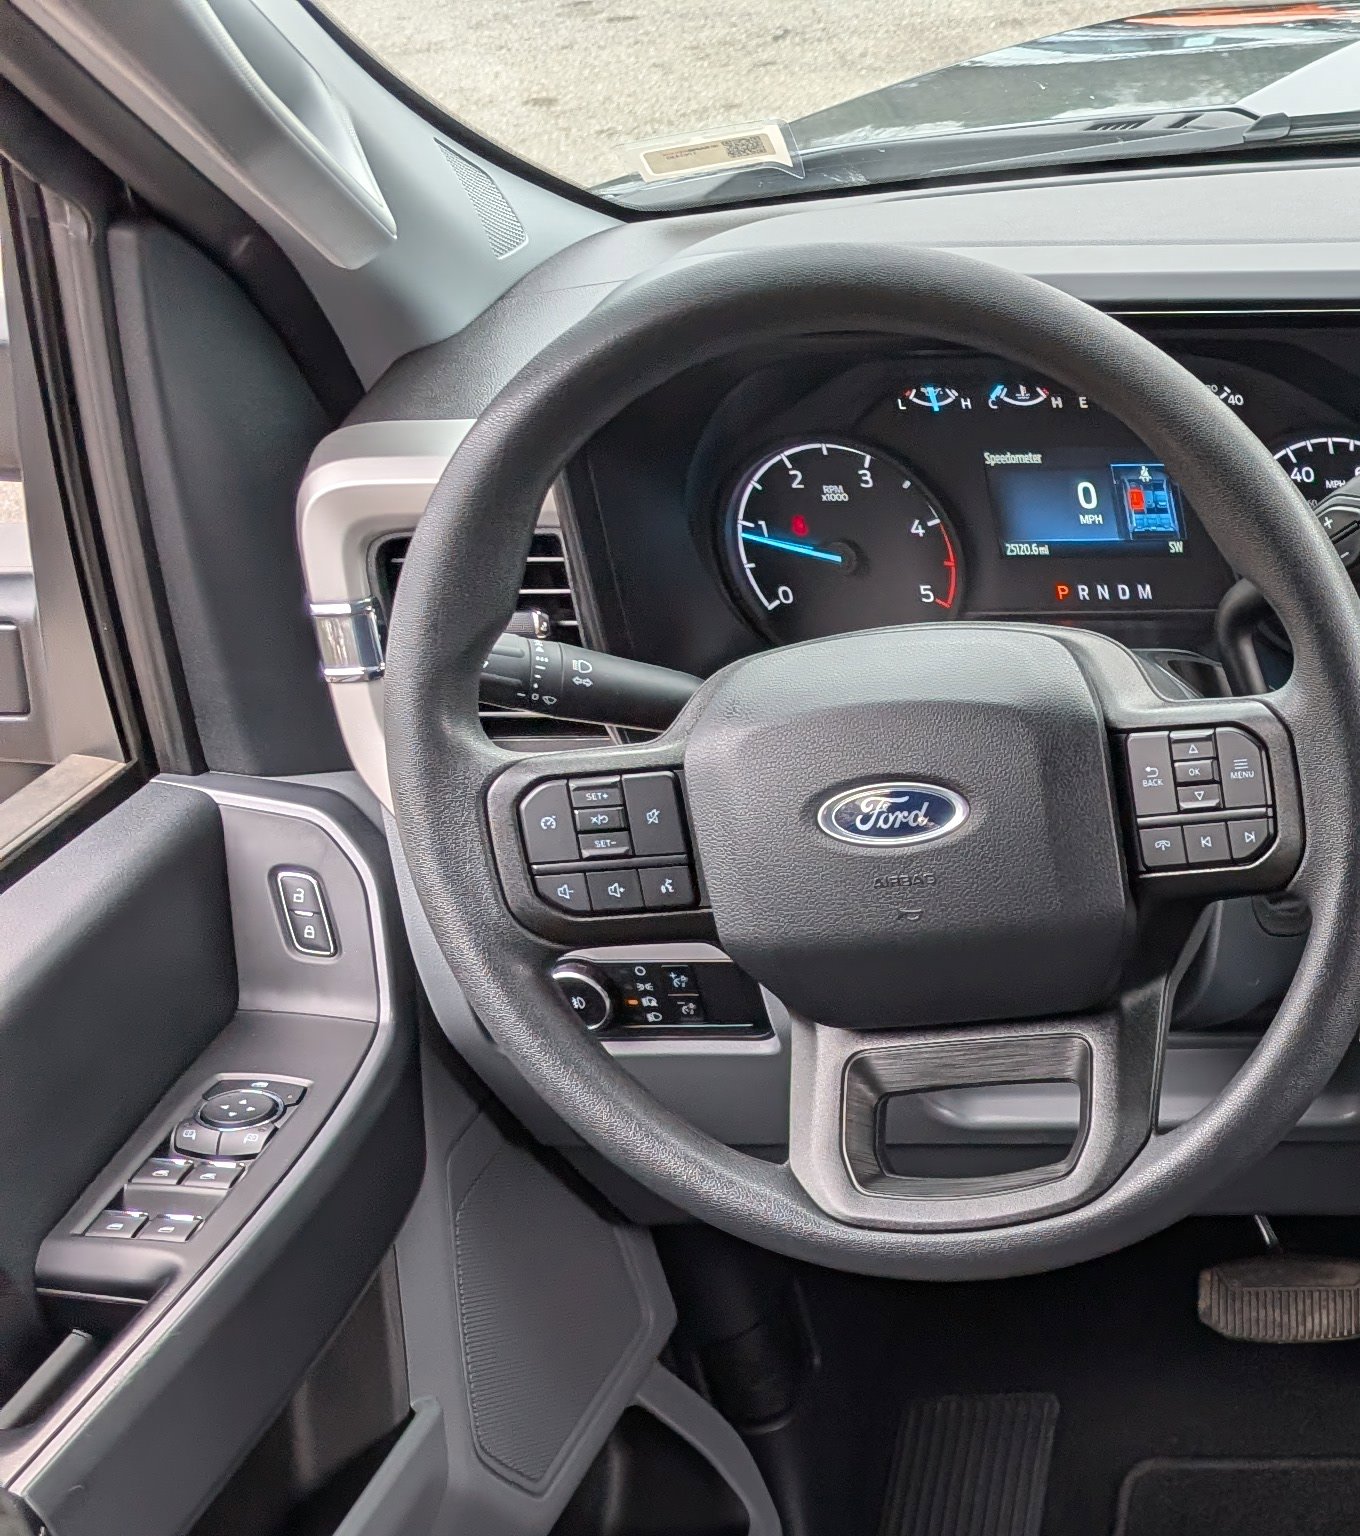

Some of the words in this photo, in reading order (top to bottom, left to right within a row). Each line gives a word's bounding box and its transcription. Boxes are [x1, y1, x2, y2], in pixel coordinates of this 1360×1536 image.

[897, 398, 907, 410] L
[960, 398, 972, 410] H
[988, 398, 999, 410] C
[1051, 397, 1064, 409] H
[1078, 396, 1089, 409] E
[1227, 394, 1244, 406] 40
[983, 451, 1043, 467] Speedometer
[788, 469, 805, 489] 2
[857, 469, 874, 488] 3
[1290, 466, 1315, 483] 40
[822, 485, 844, 494] RPM
[1076, 480, 1099, 510] 0
[821, 493, 850, 502] x1000
[1079, 514, 1104, 525] MPH
[757, 520, 769, 538] 1
[910, 519, 926, 538] 4
[1168, 541, 1184, 553] SW
[777, 585, 794, 604] 0
[919, 584, 935, 603] 5
[1057, 585, 1069, 600] P
[1077, 584, 1090, 601] R
[1097, 584, 1111, 601] N
[1117, 584, 1130, 600] D
[1137, 583, 1153, 600] M
[1188, 768, 1201, 776] OK
[1230, 770, 1255, 779] MENU
[1142, 778, 1164, 788] BACK
[855, 795, 930, 832] Ford
